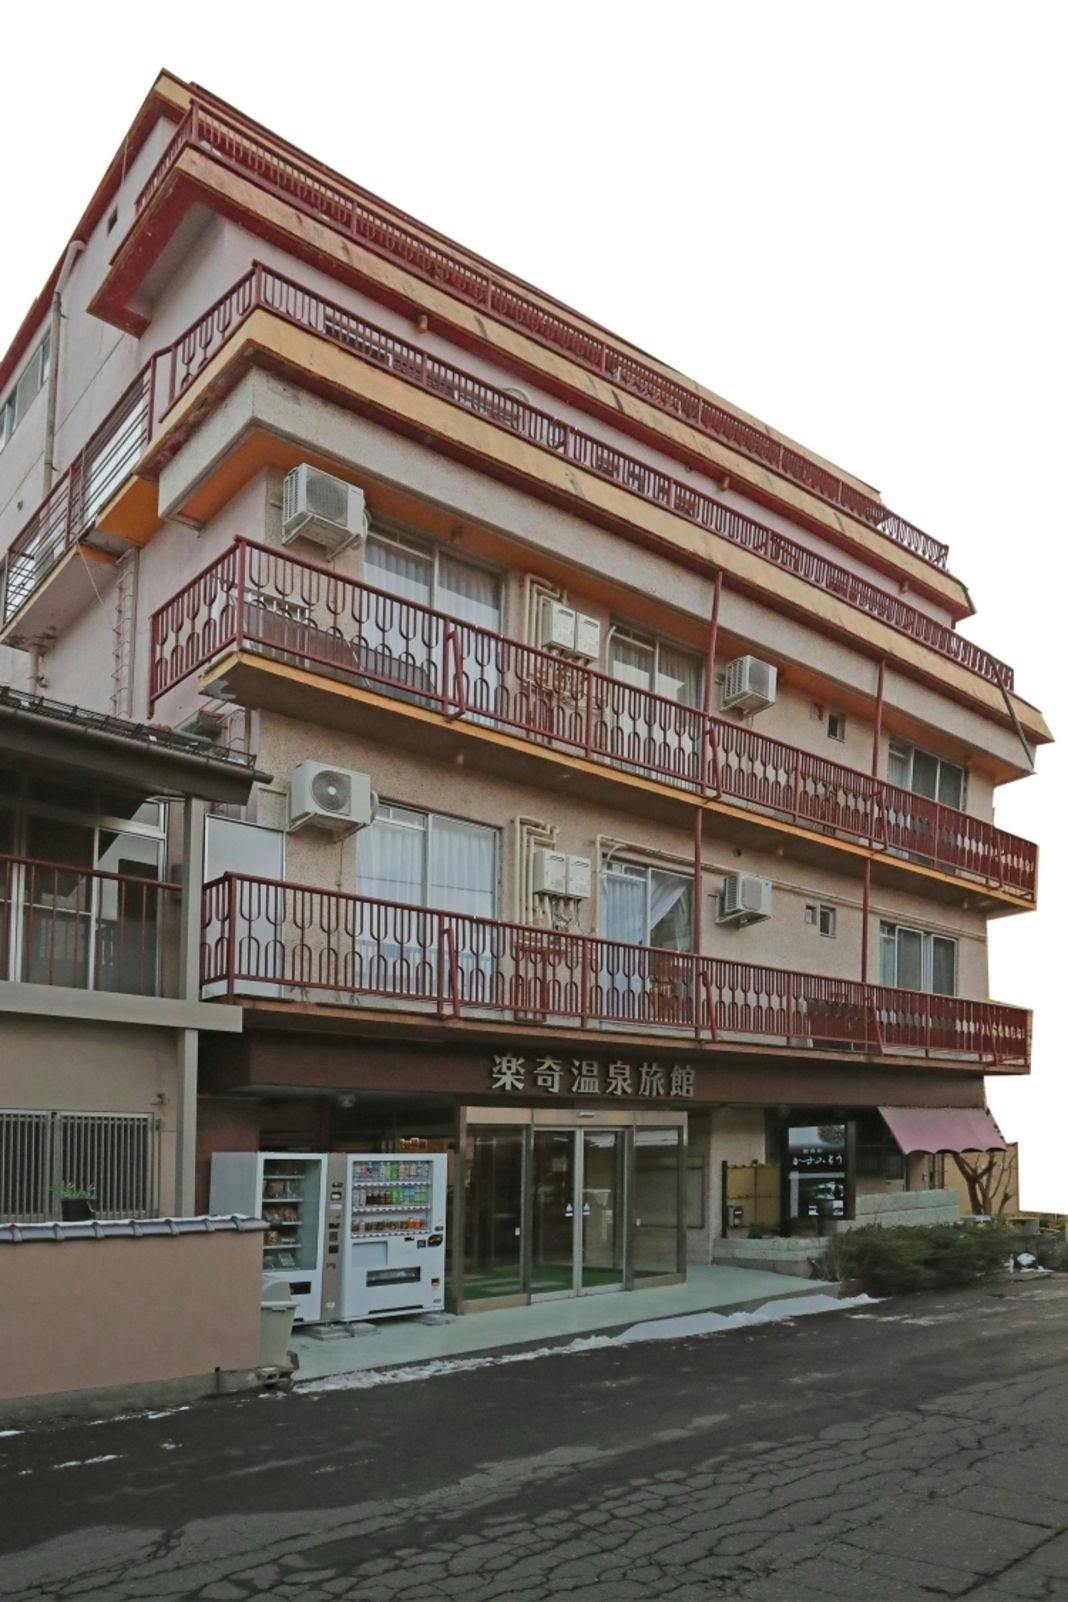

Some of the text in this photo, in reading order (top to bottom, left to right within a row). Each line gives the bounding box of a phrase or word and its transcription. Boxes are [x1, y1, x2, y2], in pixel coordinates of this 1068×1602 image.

[491, 1053, 695, 1097] 楽奇温泉旅館
